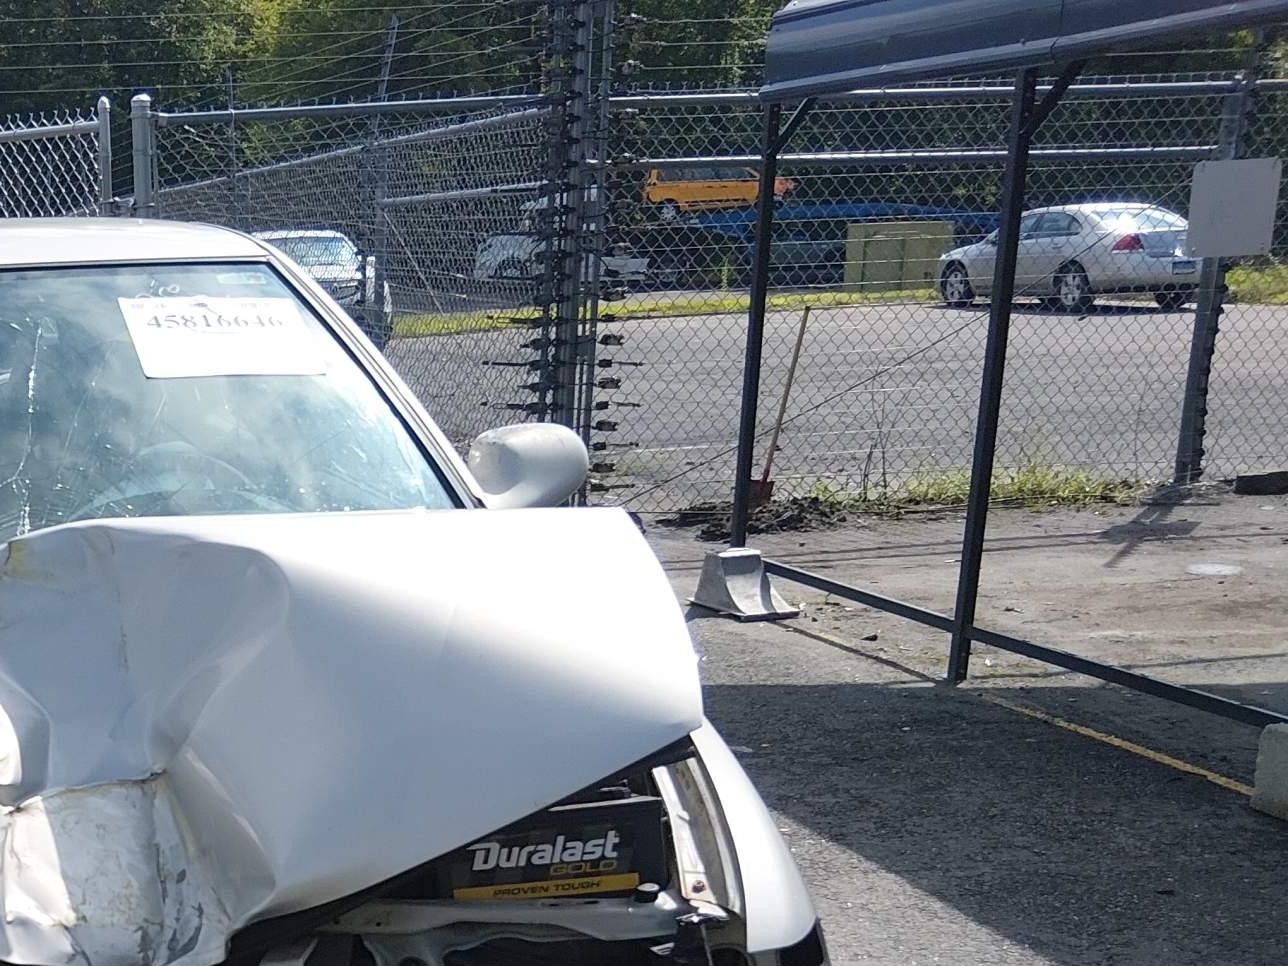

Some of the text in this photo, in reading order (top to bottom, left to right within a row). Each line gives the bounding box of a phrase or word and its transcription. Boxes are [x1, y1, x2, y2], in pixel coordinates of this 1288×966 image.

[466, 830, 621, 871] Duralast
[550, 859, 618, 876] GOLD
[493, 879, 601, 897] PROVEN TOUGH
